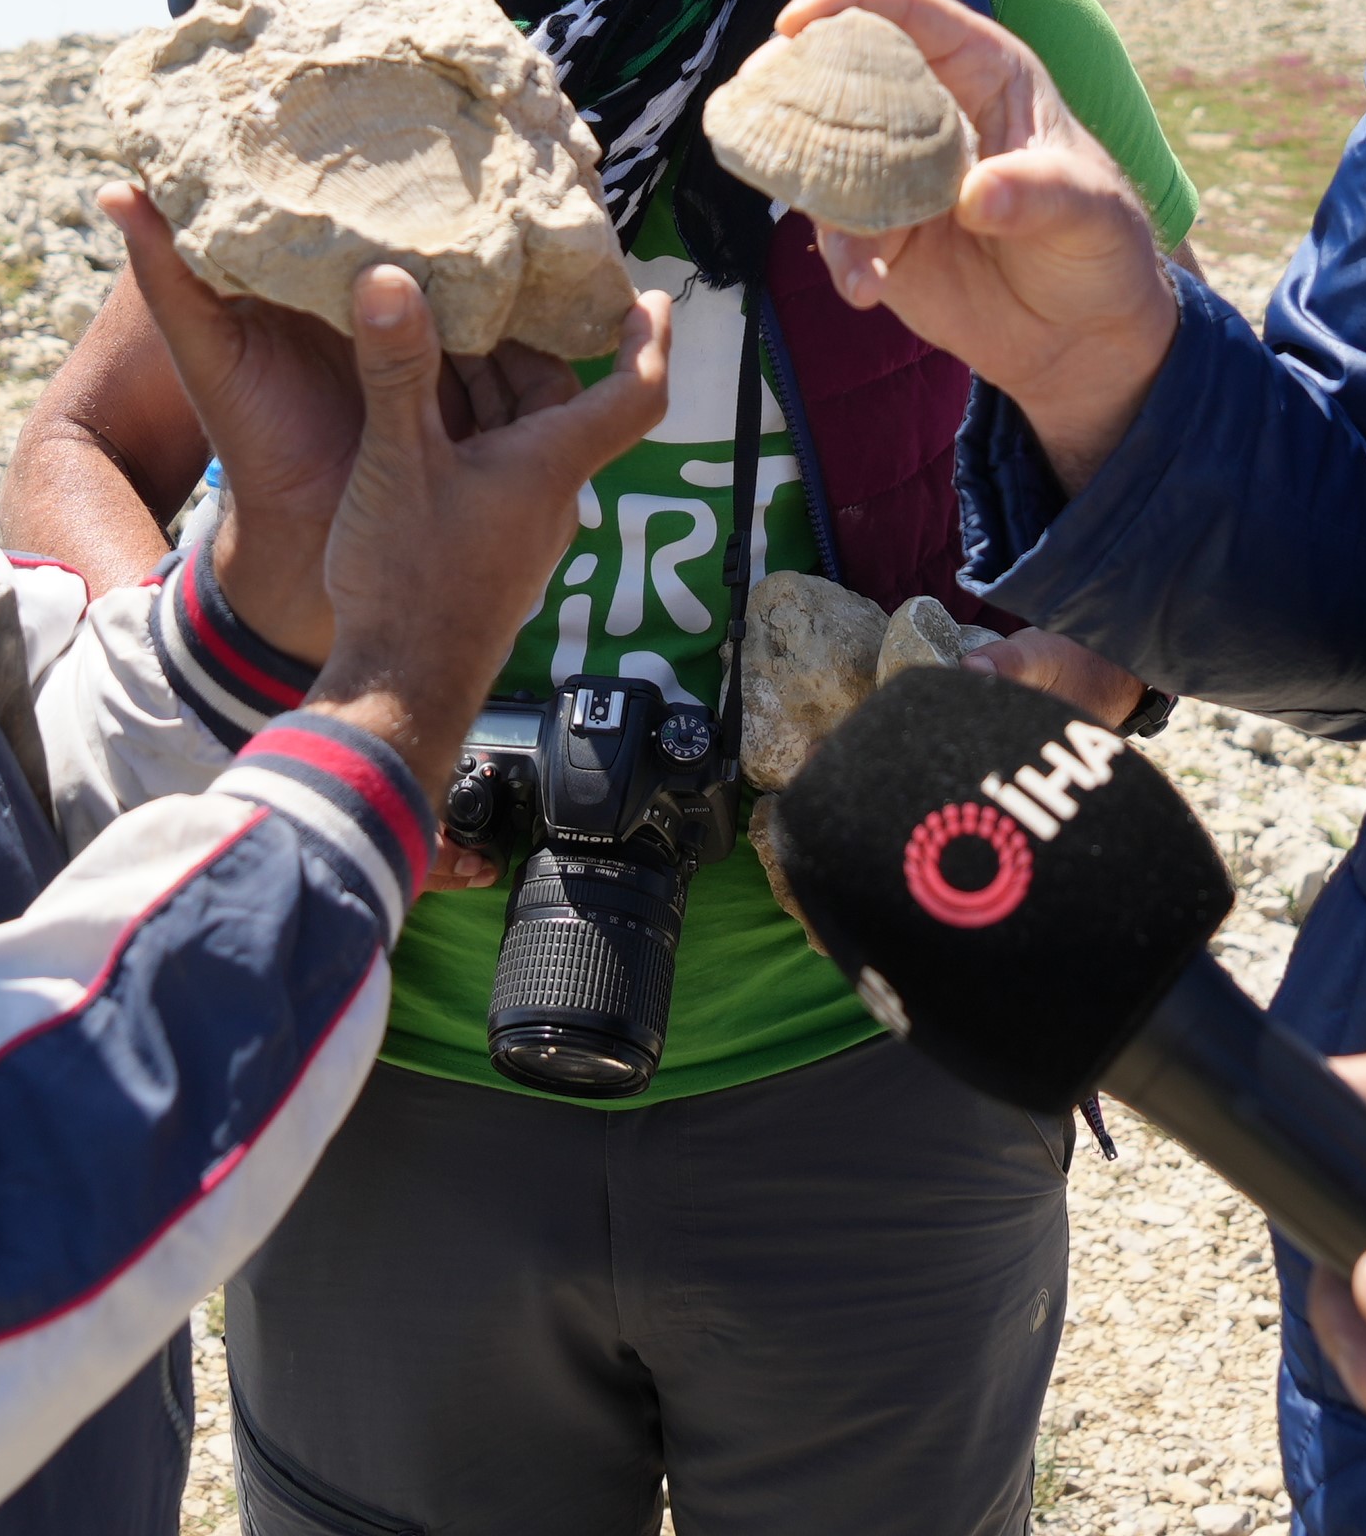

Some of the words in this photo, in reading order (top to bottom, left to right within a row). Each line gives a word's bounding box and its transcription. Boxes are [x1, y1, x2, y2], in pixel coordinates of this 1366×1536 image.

[556, 831, 614, 845] Nikon
[594, 867, 619, 878] Nikon
[609, 915, 620, 924] 35
[626, 919, 637, 930] 50
[645, 927, 653, 937] 70
